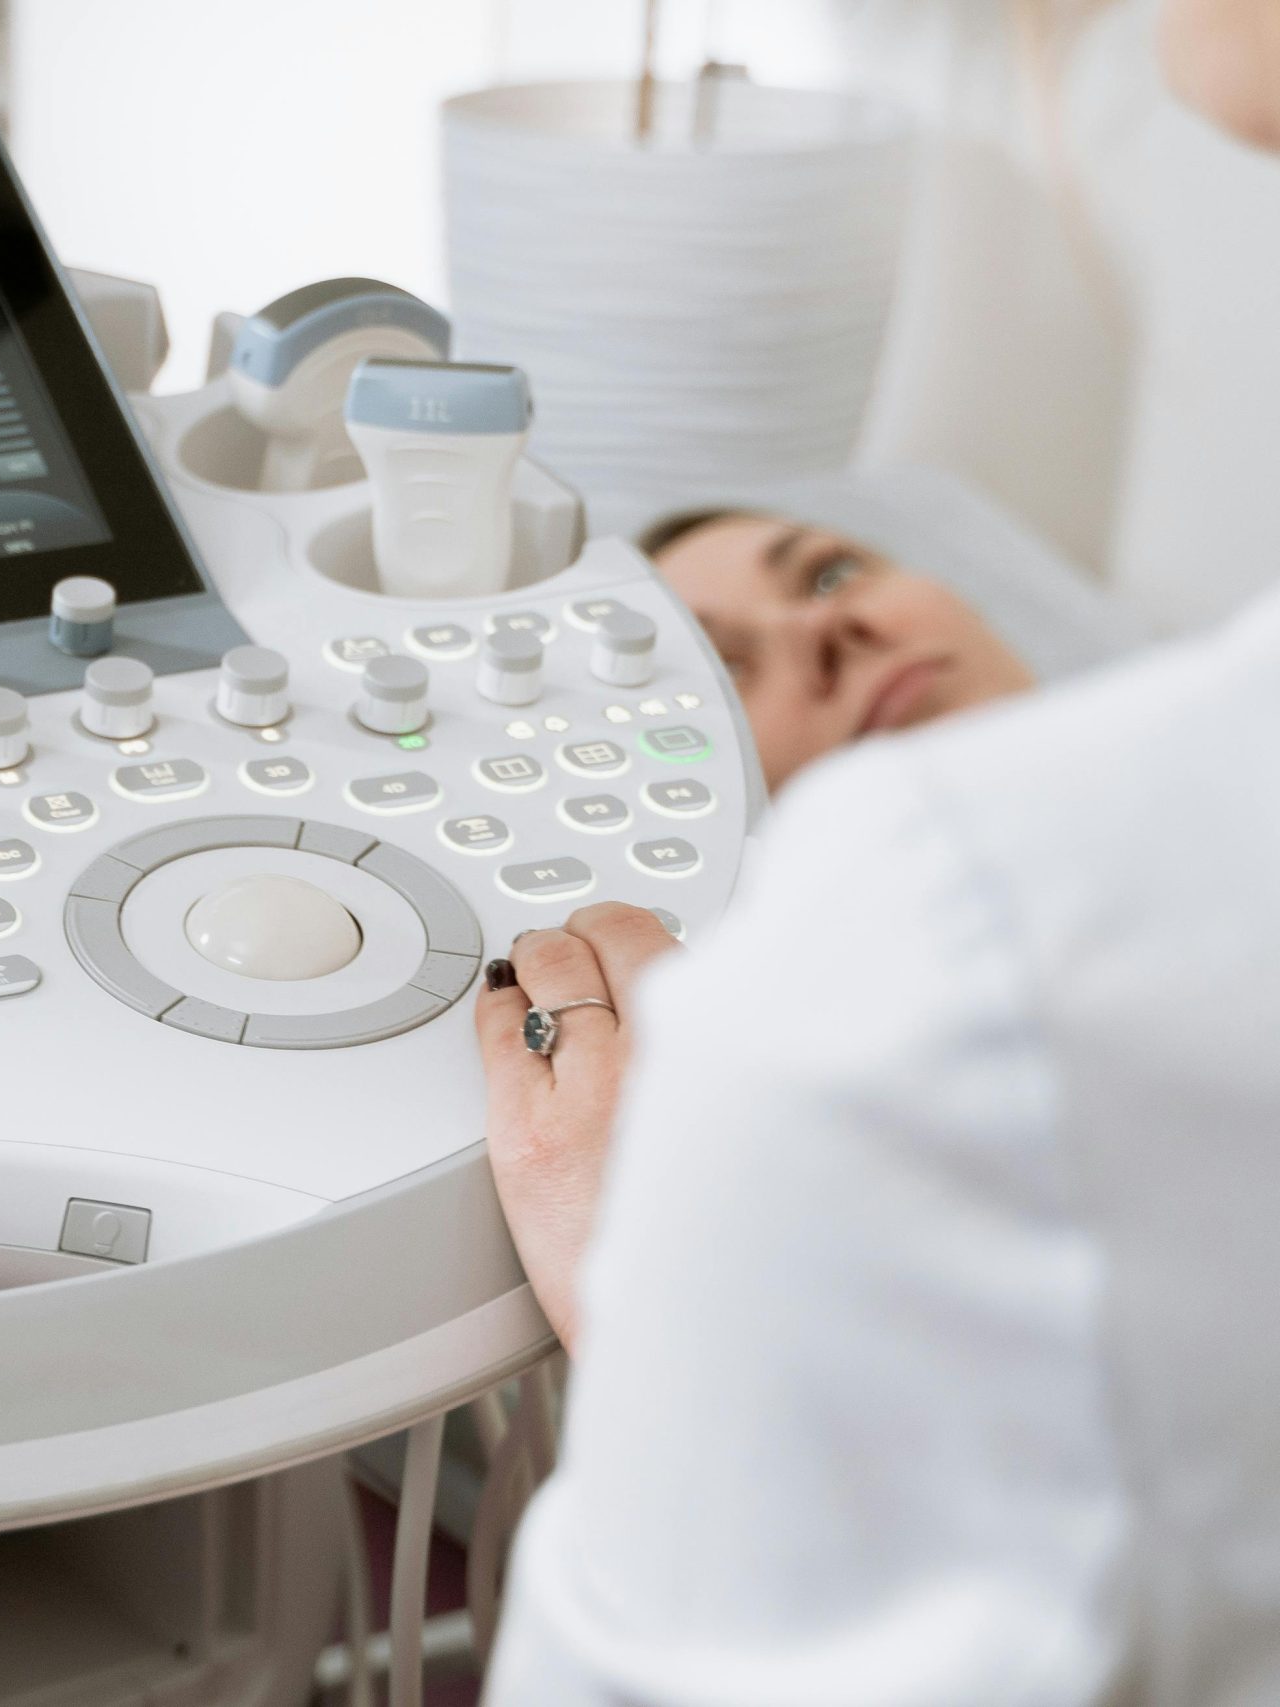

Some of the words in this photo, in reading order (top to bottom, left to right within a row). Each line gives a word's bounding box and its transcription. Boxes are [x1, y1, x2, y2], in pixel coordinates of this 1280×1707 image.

[264, 765, 291, 778] 3D
[382, 782, 409, 794] 4D
[583, 802, 609, 816] P3
[652, 847, 679, 860] P2
[534, 868, 558, 881] P1
